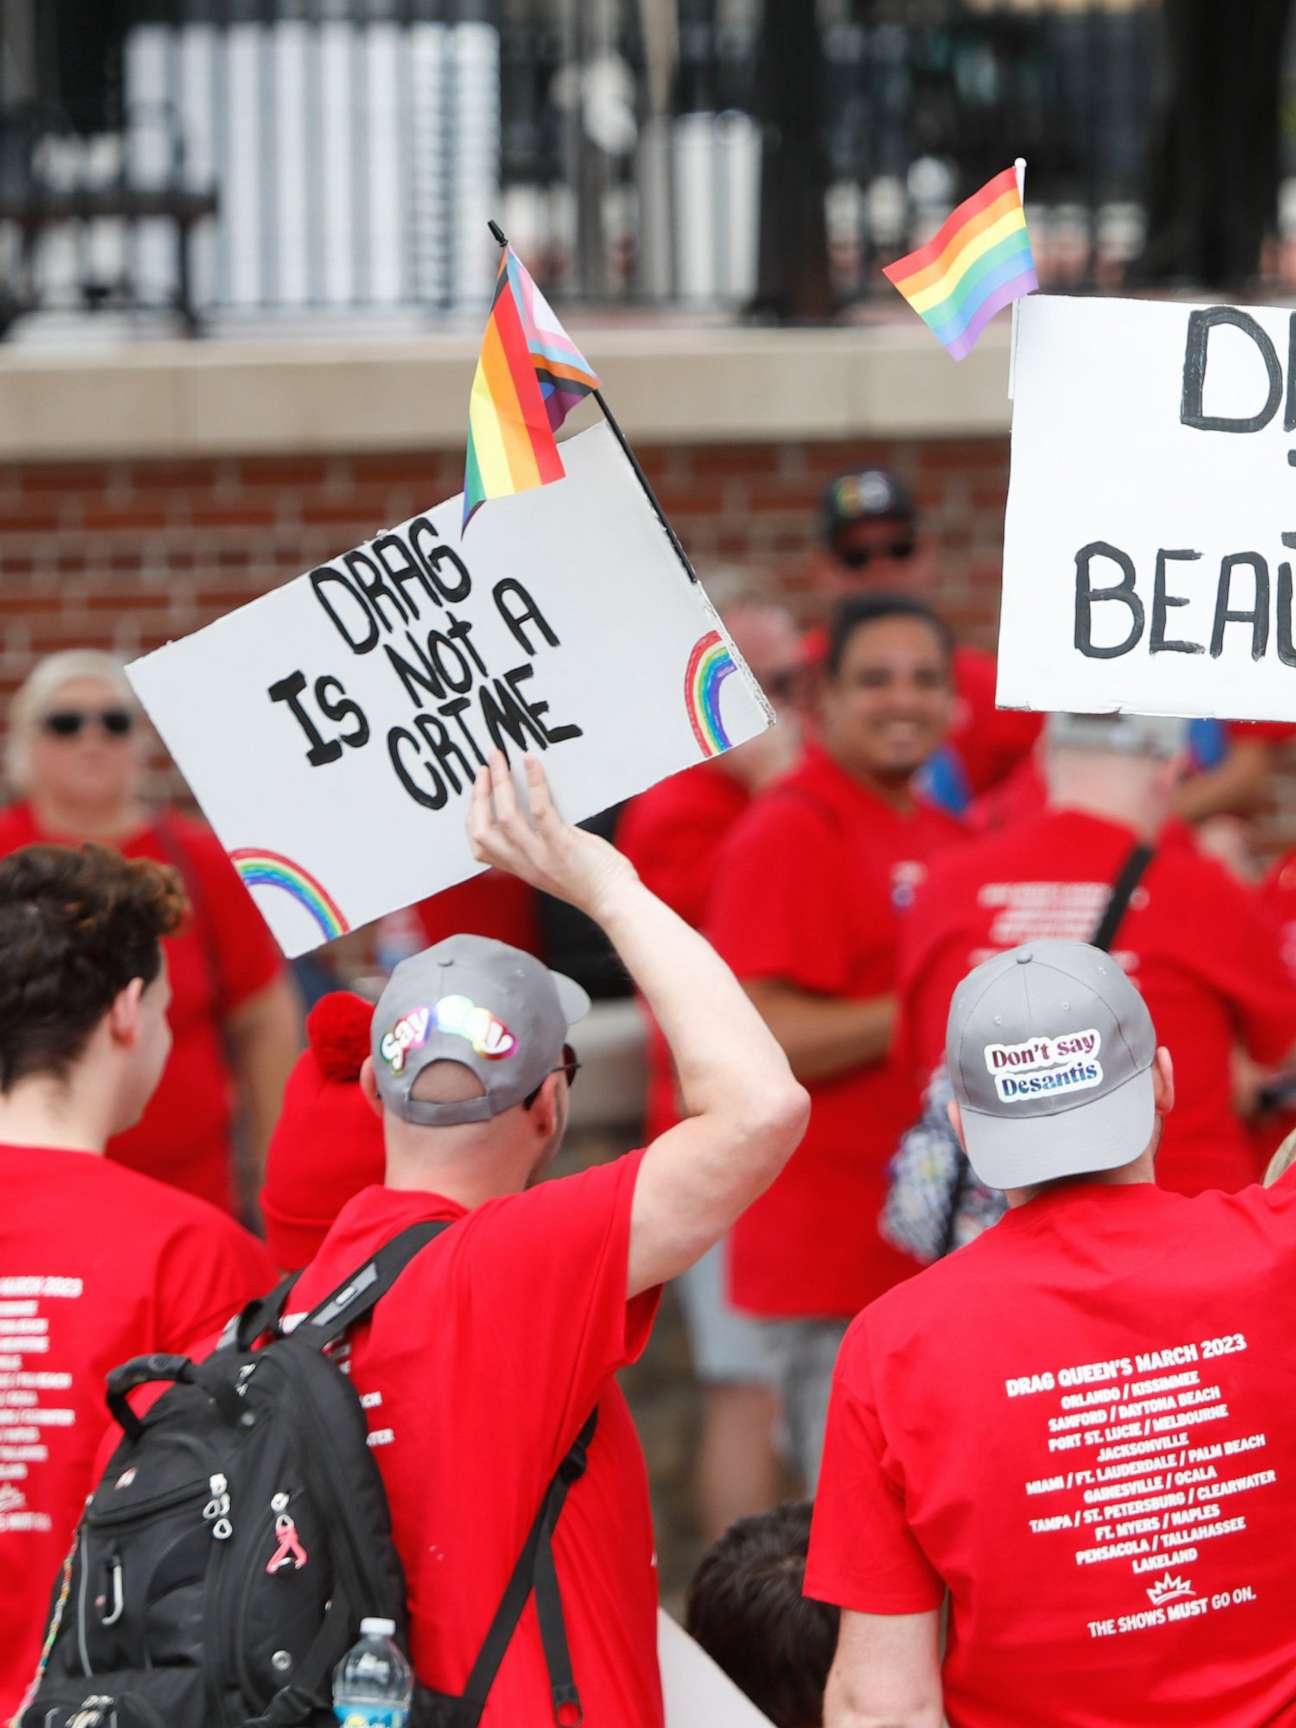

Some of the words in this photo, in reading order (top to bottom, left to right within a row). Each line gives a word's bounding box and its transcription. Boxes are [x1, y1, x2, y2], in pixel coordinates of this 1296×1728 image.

[309, 518, 471, 654] DRAG
[268, 671, 369, 766] IS
[493, 578, 560, 656] A
[388, 664, 582, 810] CRIME
[992, 1044, 1050, 1068] Don't
[1057, 1034, 1095, 1056] say
[1002, 1062, 1098, 1096] Desantis
[1005, 1371, 1054, 1397] DRAG
[1057, 1357, 1133, 1387] QUEEN'S
[1135, 1343, 1198, 1372] MARCH
[1200, 1333, 1246, 1358] 2023
[1048, 1409, 1107, 1431] SANFORD
[1117, 1395, 1177, 1419] DAYTONA
[1177, 1385, 1220, 1406] BEACH
[1060, 1386, 1120, 1409] ORLANDO
[1130, 1370, 1199, 1396] KISSIMMEE
[1048, 1433, 1081, 1451] PORT
[1083, 1429, 1104, 1444] ST.
[1104, 1421, 1142, 1441] LUCIE
[1152, 1403, 1228, 1431] MELBOURNE
[1096, 1432, 1189, 1462] JACKSONVILLE
[1025, 1475, 1064, 1494] MIAMI
[1074, 1470, 1095, 1485] FT.
[1095, 1453, 1177, 1481] LAUDERDALE
[1187, 1443, 1222, 1462] PALM
[1223, 1433, 1265, 1454] BEACH
[1083, 1475, 1164, 1503] GAINESVILLE
[1174, 1465, 1217, 1485] OCALA
[1029, 1514, 1072, 1532] TAMPA
[1082, 1507, 1102, 1523] ST.
[1103, 1491, 1185, 1519] PETERSBURG
[1196, 1469, 1275, 1500] CLEARWATER
[1094, 1525, 1115, 1541] FT.
[1115, 1516, 1160, 1537] MYERS
[1170, 1503, 1220, 1525] NAPLES
[1075, 1538, 1150, 1564] PENSACOLA
[1160, 1516, 1245, 1547] TALLAHASSEE
[1132, 1547, 1197, 1573] LAKELAND
[1087, 1618, 1116, 1637] THE
[1117, 1604, 1166, 1632] SHOWS
[1166, 1597, 1208, 1621] MUST
[1211, 1592, 1230, 1609] GO
[1232, 1586, 1256, 1603] ON.
